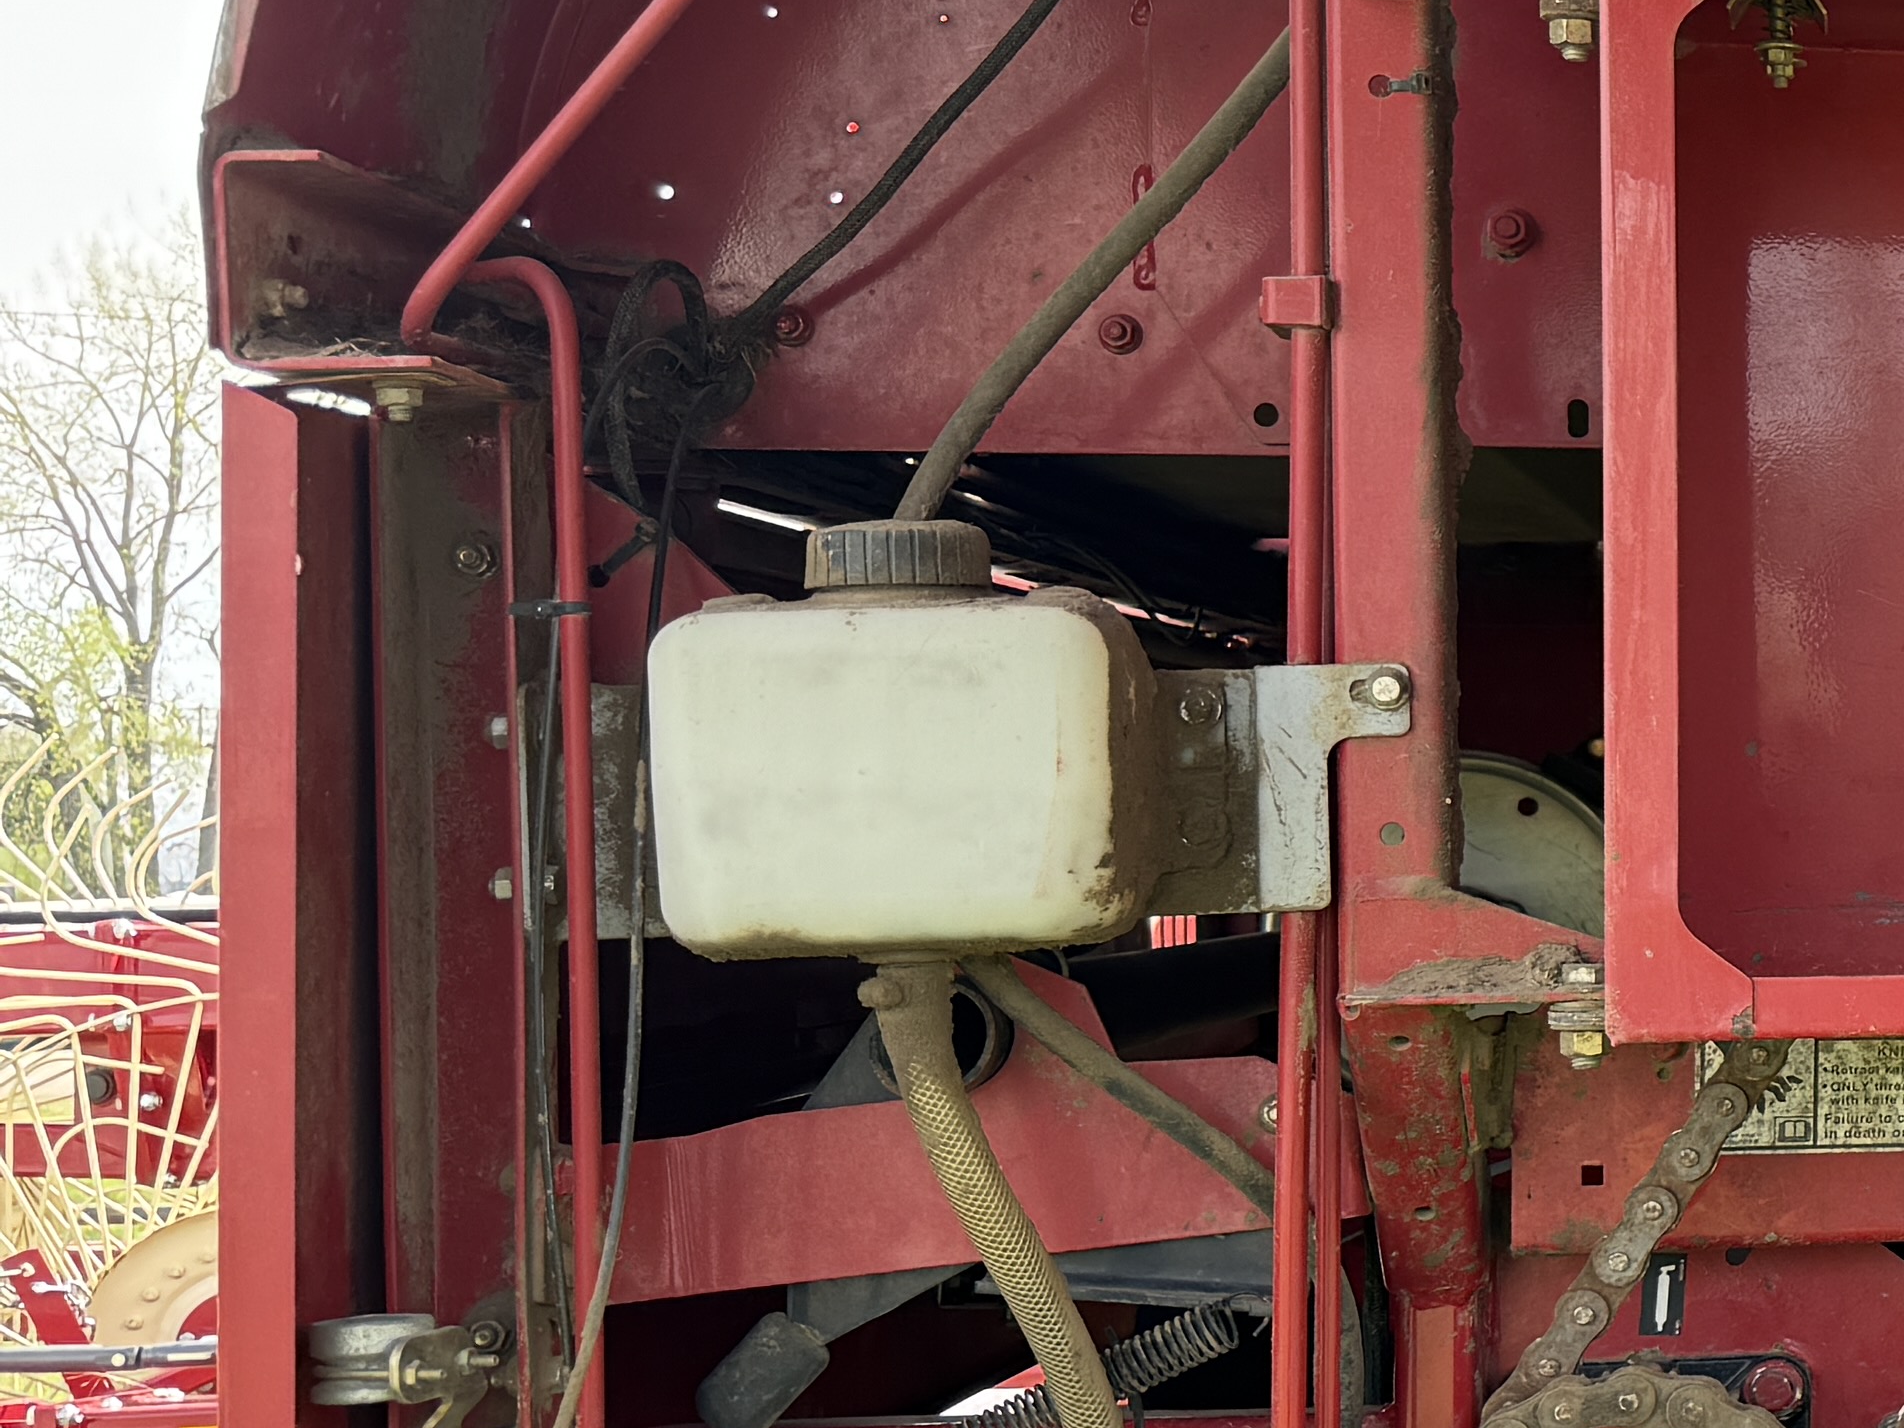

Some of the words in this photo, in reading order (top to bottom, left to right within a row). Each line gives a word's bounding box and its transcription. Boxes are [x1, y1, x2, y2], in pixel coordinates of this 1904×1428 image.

[1831, 1081, 1869, 1092] ONLY
[1830, 1095, 1858, 1105] with
[1864, 1094, 1897, 1105] knife
[1824, 1112, 1873, 1124] Failure
[1879, 1113, 1892, 1123] to
[1844, 1127, 1886, 1138] death
